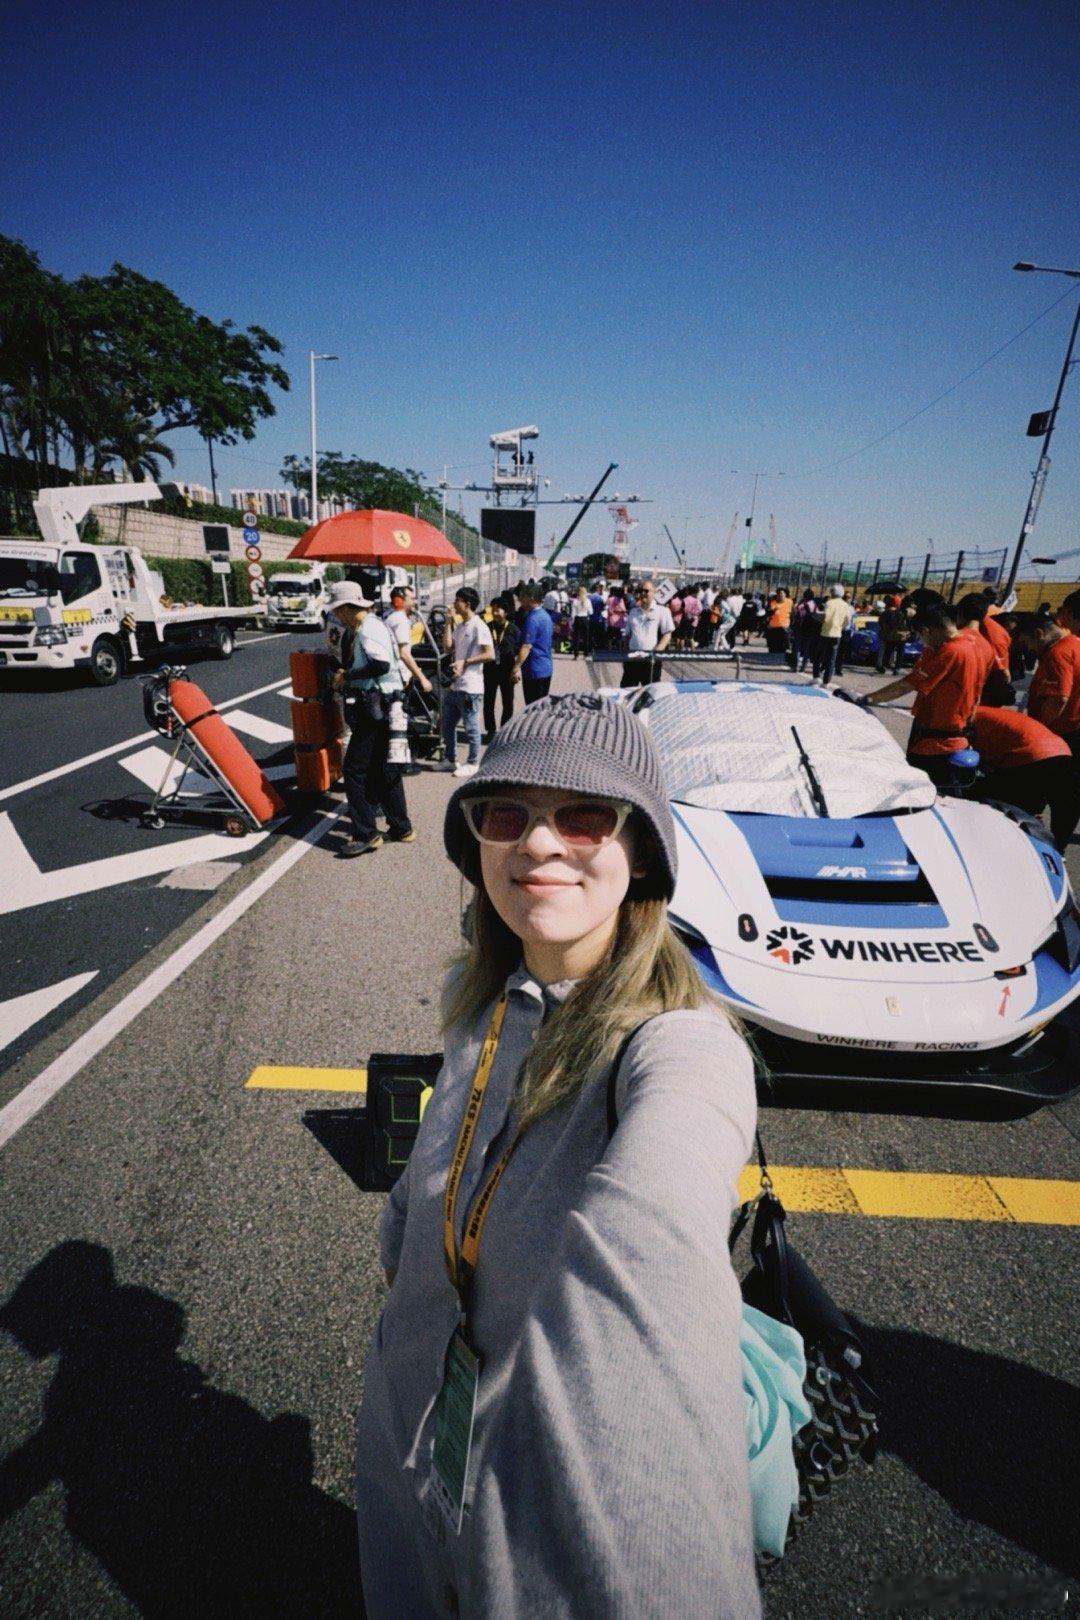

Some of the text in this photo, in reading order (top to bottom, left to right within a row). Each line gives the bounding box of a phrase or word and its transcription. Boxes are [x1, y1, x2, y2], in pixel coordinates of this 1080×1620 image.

[245, 515, 255, 524] 40
[245, 532, 258, 541] 20
[820, 938, 984, 963] WINHERE
[817, 1033, 980, 1051] WINHERE RACING
